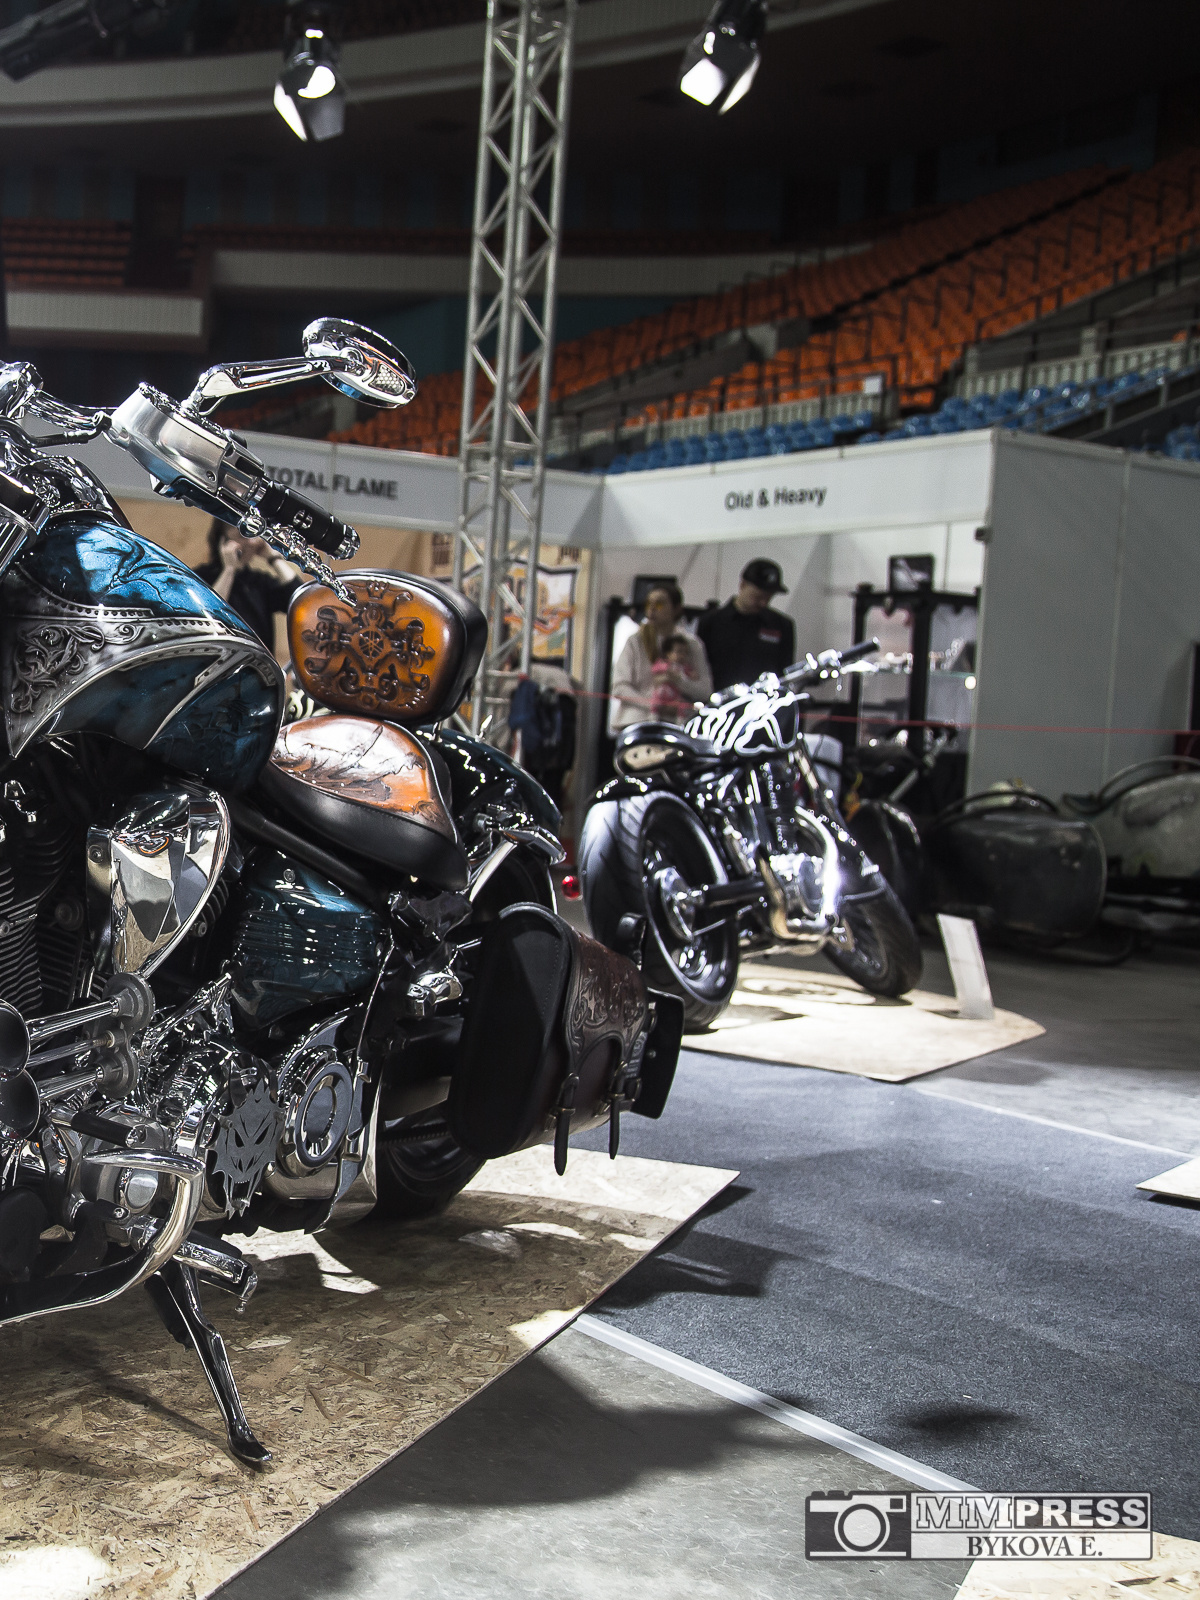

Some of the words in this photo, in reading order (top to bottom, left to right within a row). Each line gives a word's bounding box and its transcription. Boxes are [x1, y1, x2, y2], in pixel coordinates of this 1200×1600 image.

[267, 465, 329, 491] TOTAL
[331, 474, 398, 499] FLAME
[724, 490, 754, 511] Old
[757, 487, 769, 508] &
[773, 486, 828, 508] Heavy
